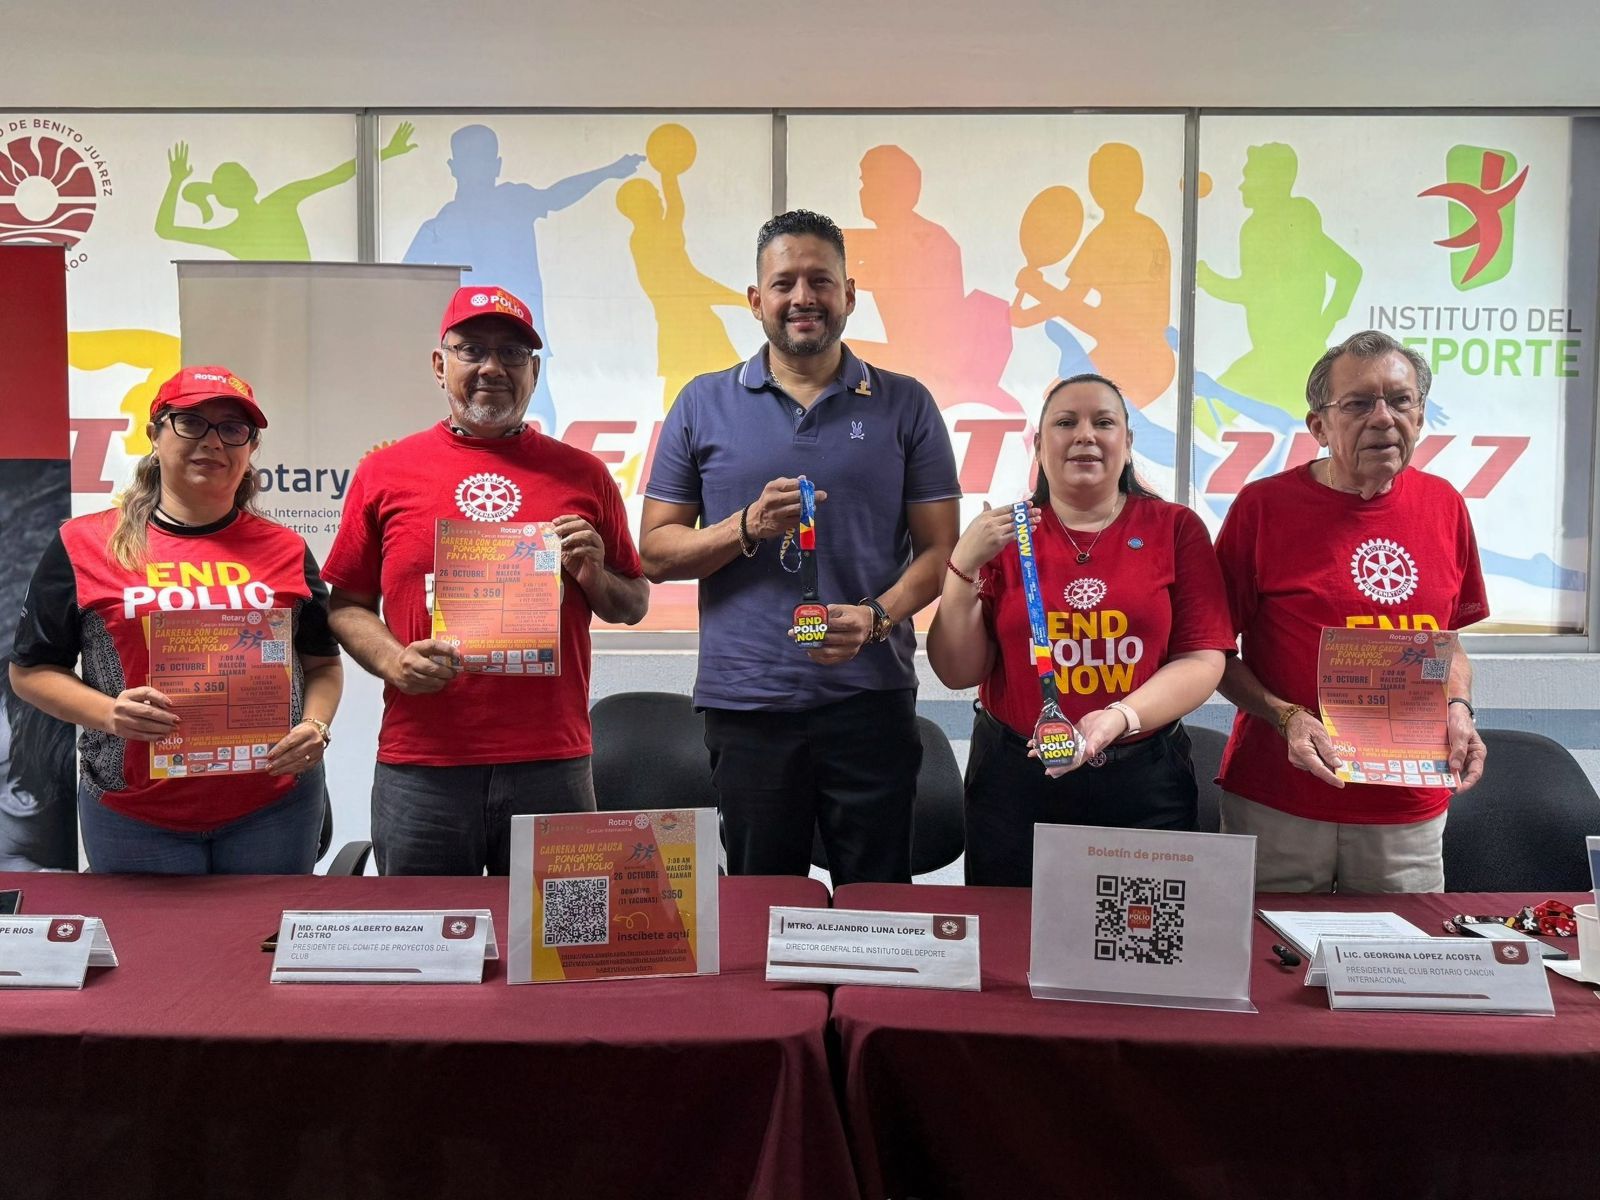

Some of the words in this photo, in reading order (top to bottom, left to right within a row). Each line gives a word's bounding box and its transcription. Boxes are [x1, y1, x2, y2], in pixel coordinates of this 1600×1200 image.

[9, 119, 27, 131] DE
[33, 119, 83, 143] BENITO
[84, 145, 113, 197] JUÁREZ
[65, 253, 88, 272] OO
[1369, 306, 1518, 331] INSTITUTO
[1527, 308, 1582, 333] DEL
[1401, 337, 1582, 378] PORTE
[257, 464, 350, 500] otary
[275, 508, 343, 518] Internacion
[284, 523, 318, 534] strito
[500, 527, 522, 535] Rotary
[475, 538, 490, 546] CON
[1016, 524, 1031, 557] NOW
[453, 545, 497, 554] PONGAMOS
[146, 561, 251, 588] END
[452, 570, 485, 578] OCTUBRE
[473, 589, 479, 598] $
[483, 588, 500, 597] 350
[123, 581, 275, 619] POLIO
[221, 614, 245, 622] Rotary
[798, 617, 822, 625] END
[794, 624, 828, 633] POLIO
[1047, 609, 1128, 640] END
[155, 629, 191, 638] CARRERA
[194, 628, 211, 636] CON
[797, 632, 825, 642] NOW
[169, 636, 219, 645] PONGAMOS
[162, 645, 178, 653] FIN
[201, 643, 229, 652] POLIO
[155, 663, 165, 671] 26
[170, 663, 206, 671] OCTUBRE
[1330, 658, 1344, 666] FIN
[1344, 658, 1351, 666] A
[1052, 662, 1135, 695] NOW
[1336, 675, 1368, 683] OCTUBRE
[194, 683, 200, 692] $
[204, 682, 225, 691] 350
[1358, 694, 1363, 705] $
[1367, 695, 1385, 705] 350
[156, 737, 183, 745] POLIO
[1043, 733, 1068, 744] END
[1040, 740, 1075, 751] POLIO
[1044, 748, 1073, 759] NOW
[608, 818, 633, 826] Rotary
[540, 843, 576, 855] CARRERA
[578, 843, 594, 853] CON
[597, 841, 623, 852] CAUSA
[555, 853, 604, 863] PONGAMOS
[1088, 846, 1131, 859] Boletín
[1134, 849, 1149, 860] de
[1152, 851, 1194, 863] prensa
[547, 864, 562, 874] FIN
[564, 863, 571, 873] A
[573, 863, 585, 872] LA
[587, 861, 614, 871] POLIO
[614, 872, 623, 880] 26
[627, 870, 659, 879] OCTUBRE
[661, 889, 683, 899] $350
[12, 926, 34, 935] RÍOS
[298, 924, 313, 932] MD.
[316, 924, 350, 932] CARLOS
[394, 925, 423, 933] BAZAN
[787, 922, 814, 930] MTRO.
[817, 923, 868, 933] ALEJANDRO
[871, 925, 895, 934] LUNA
[897, 926, 925, 936] LÓPEZ
[297, 931, 332, 939] CASTRO
[666, 929, 690, 942] aquí
[293, 943, 335, 951] PRESIDENTE
[338, 943, 350, 951] DEL
[381, 943, 391, 951] DE
[392, 944, 434, 952] PROYECTOS
[436, 944, 449, 952] DEL
[786, 943, 819, 951] DIRECTOR
[820, 944, 850, 952] GENERAL
[852, 946, 864, 954] DEL
[866, 946, 900, 955] INSTITUTO
[901, 948, 914, 956] DEL
[915, 949, 945, 958] DEPORTE
[290, 952, 309, 960] CLUB
[1343, 951, 1361, 960] LIC.
[1363, 952, 1411, 961] GEORGINA
[1413, 951, 1443, 961] LÓPEZ
[1445, 952, 1482, 961] ACOSTA
[1346, 966, 1391, 975] PRESIDENTA
[1393, 967, 1407, 975] DEL
[1408, 967, 1428, 975] CLUB
[1430, 968, 1462, 976] ROTARIO
[1347, 976, 1407, 985] INTERNACIONAL
